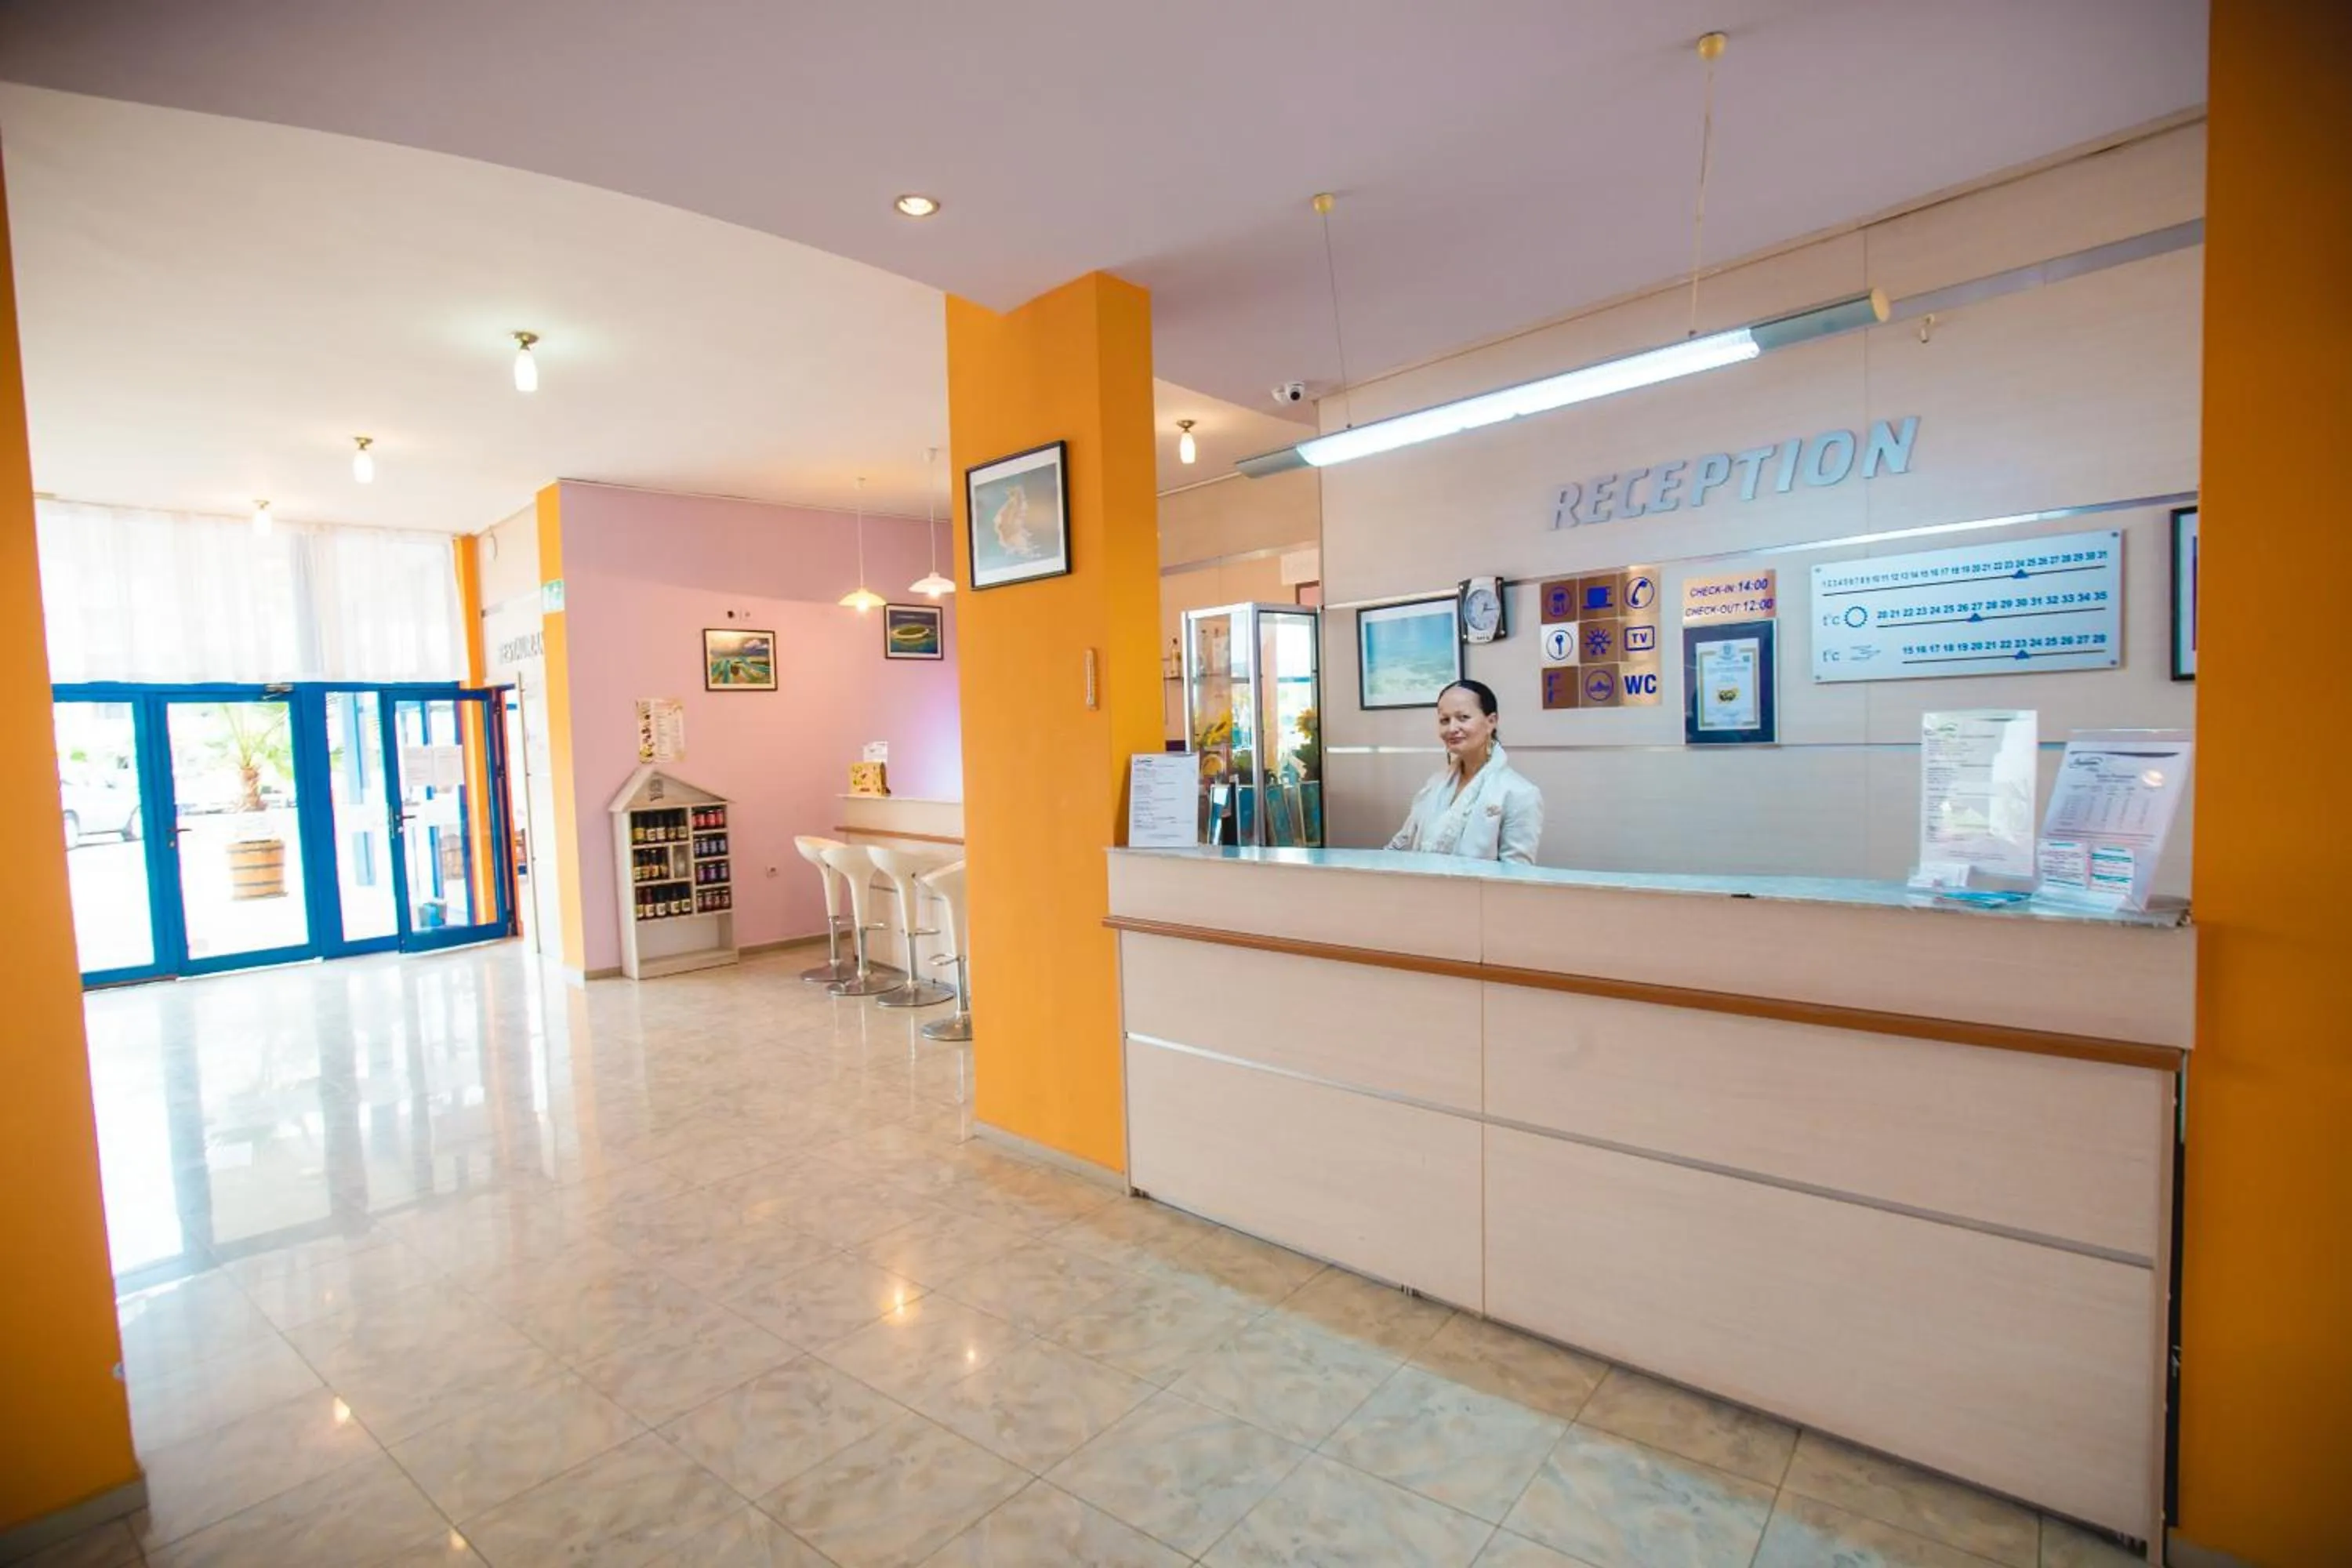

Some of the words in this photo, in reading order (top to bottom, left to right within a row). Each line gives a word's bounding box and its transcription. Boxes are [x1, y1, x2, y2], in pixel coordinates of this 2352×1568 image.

[1551, 415, 1921, 531] RECEPTION
[1738, 578, 1768, 591] 14:00
[1743, 598, 1773, 612] 12:00
[2001, 600, 2012, 608] 29
[2078, 593, 2090, 601] 34
[2094, 591, 2107, 600] 35
[1632, 633, 1647, 643] TV
[2093, 634, 2106, 643] 28
[1624, 674, 1657, 695] WC
